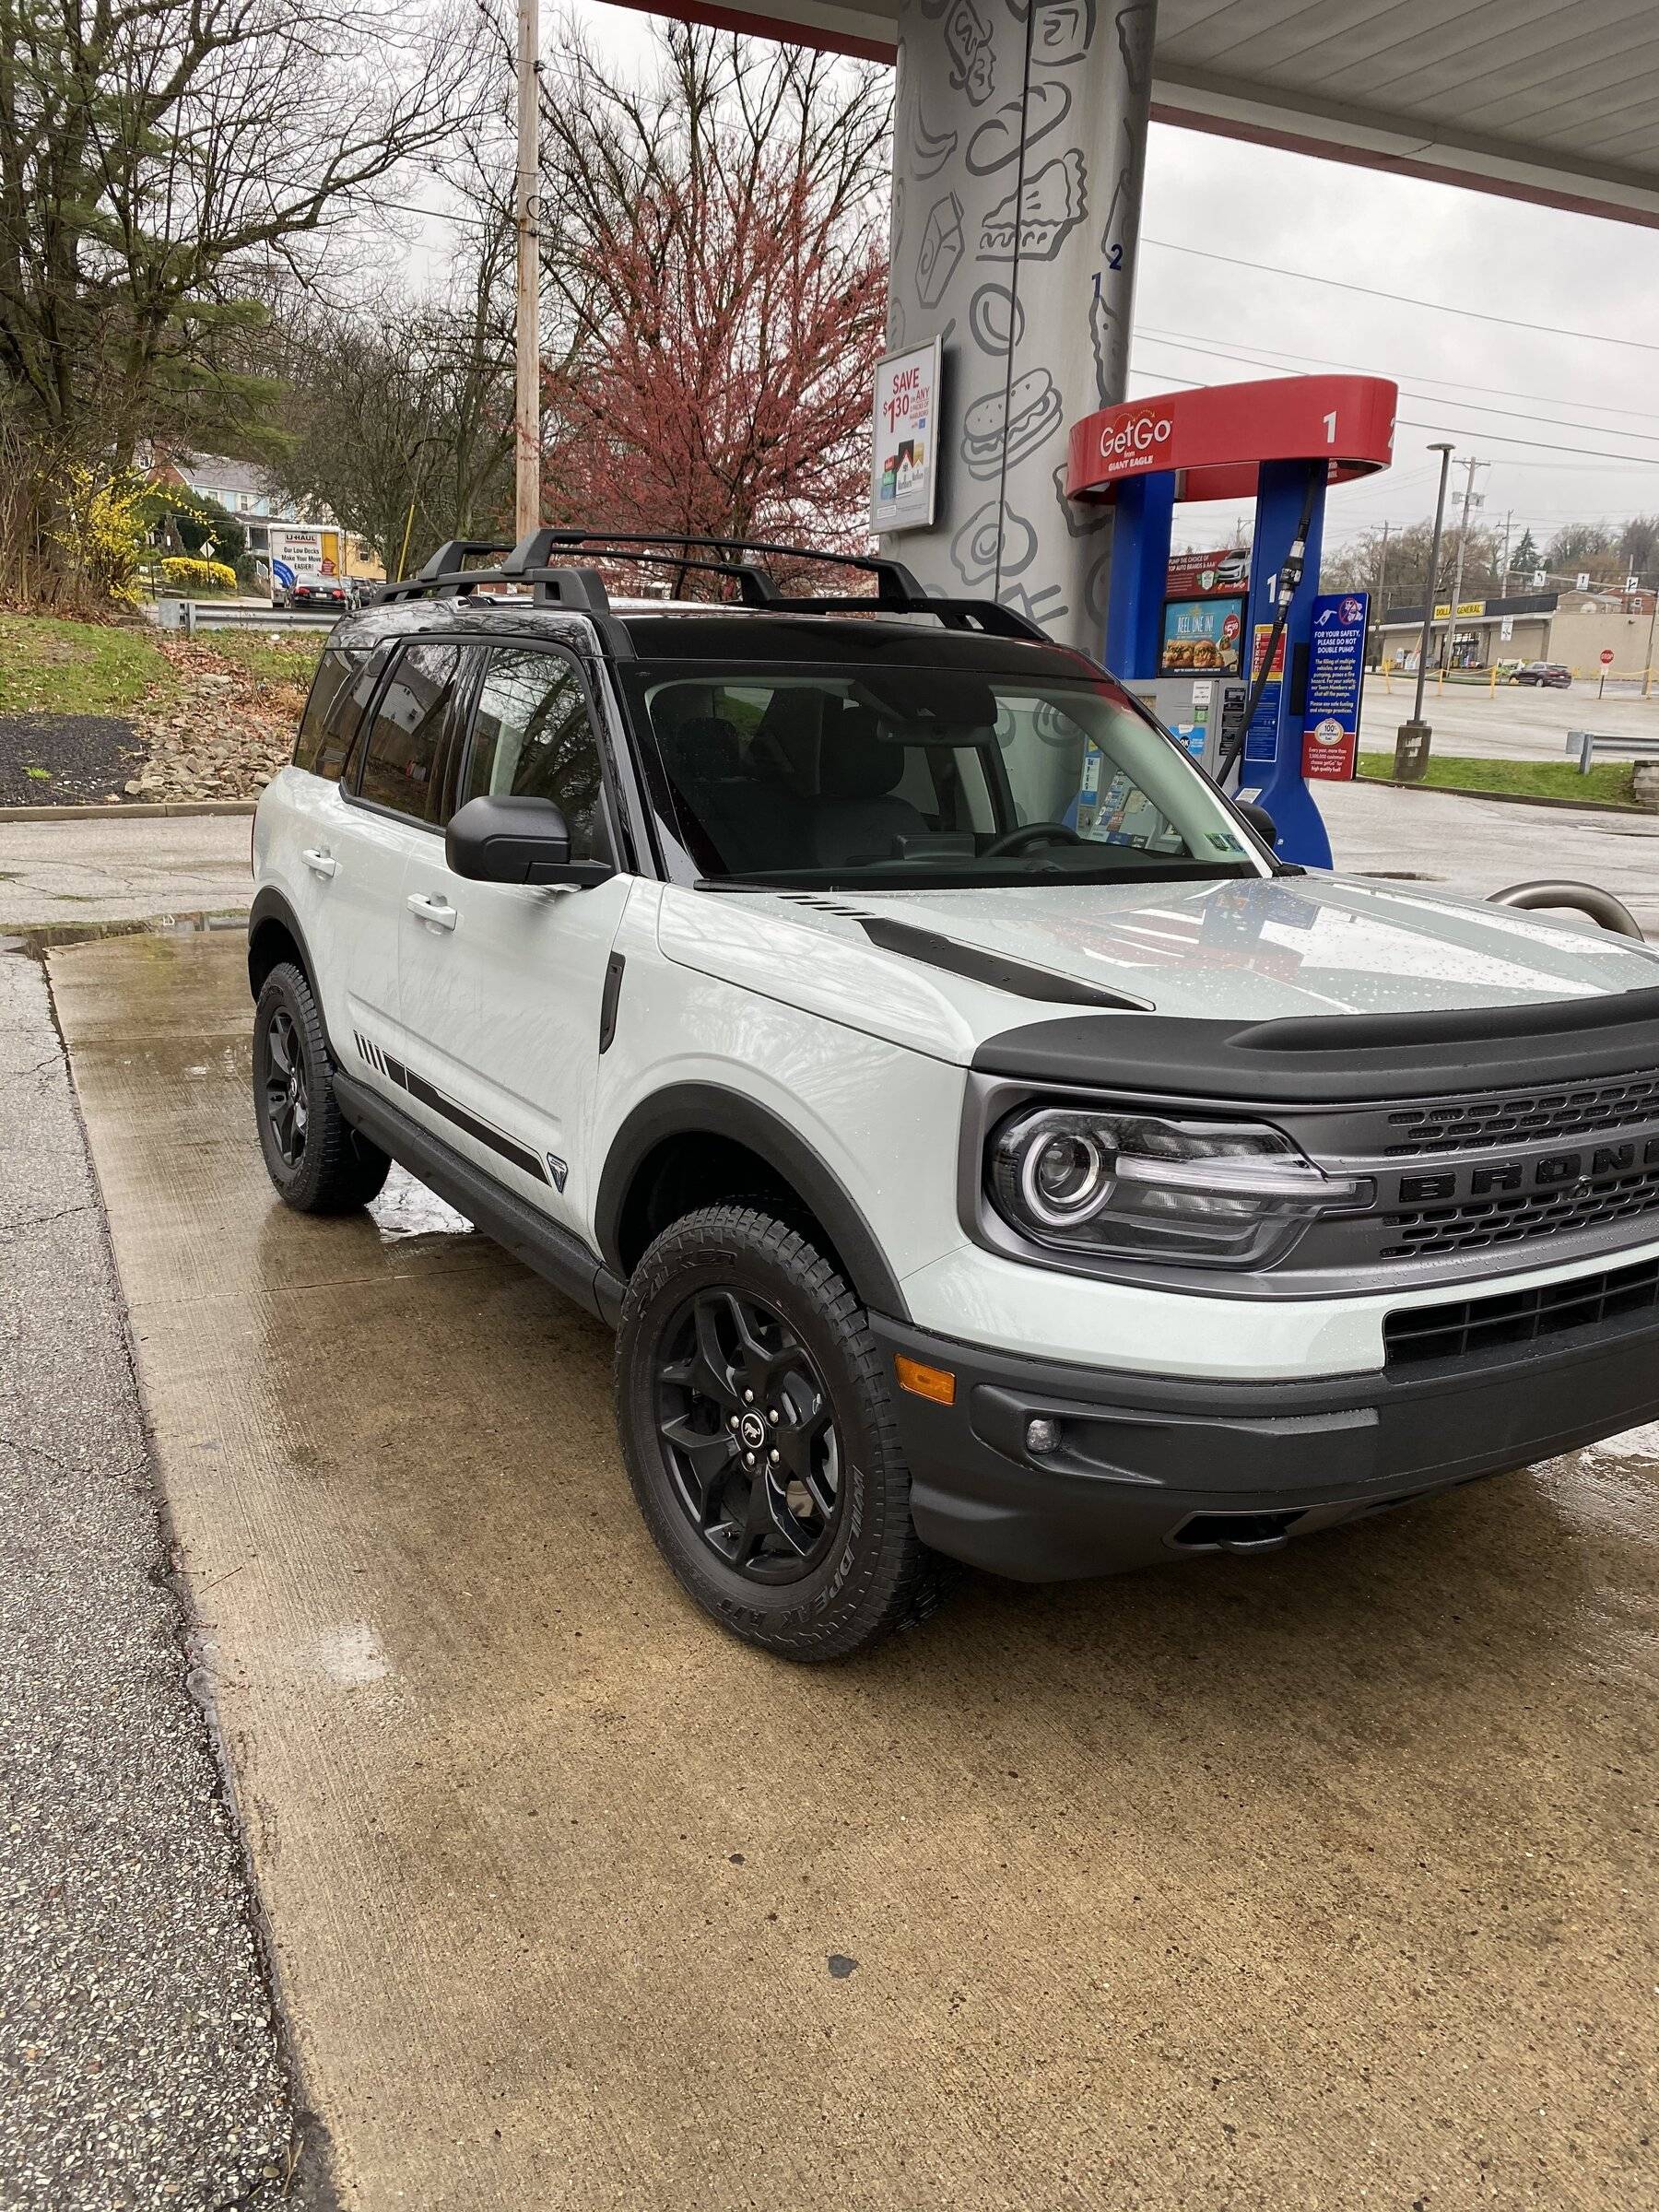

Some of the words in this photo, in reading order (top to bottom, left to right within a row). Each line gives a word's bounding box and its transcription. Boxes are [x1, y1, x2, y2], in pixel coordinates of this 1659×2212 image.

[1110, 243, 1123, 272] 2
[1091, 272, 1101, 298] 1
[893, 367, 920, 395] SAVE
[916, 386, 930, 401] ANY
[1100, 418, 1172, 457] GetGo
[1323, 411, 1337, 443] 1
[1108, 459, 1130, 471] GIANT
[1129, 454, 1154, 466] EAGLE
[1267, 573, 1277, 603] 1
[1457, 605, 1480, 614] GENERAL
